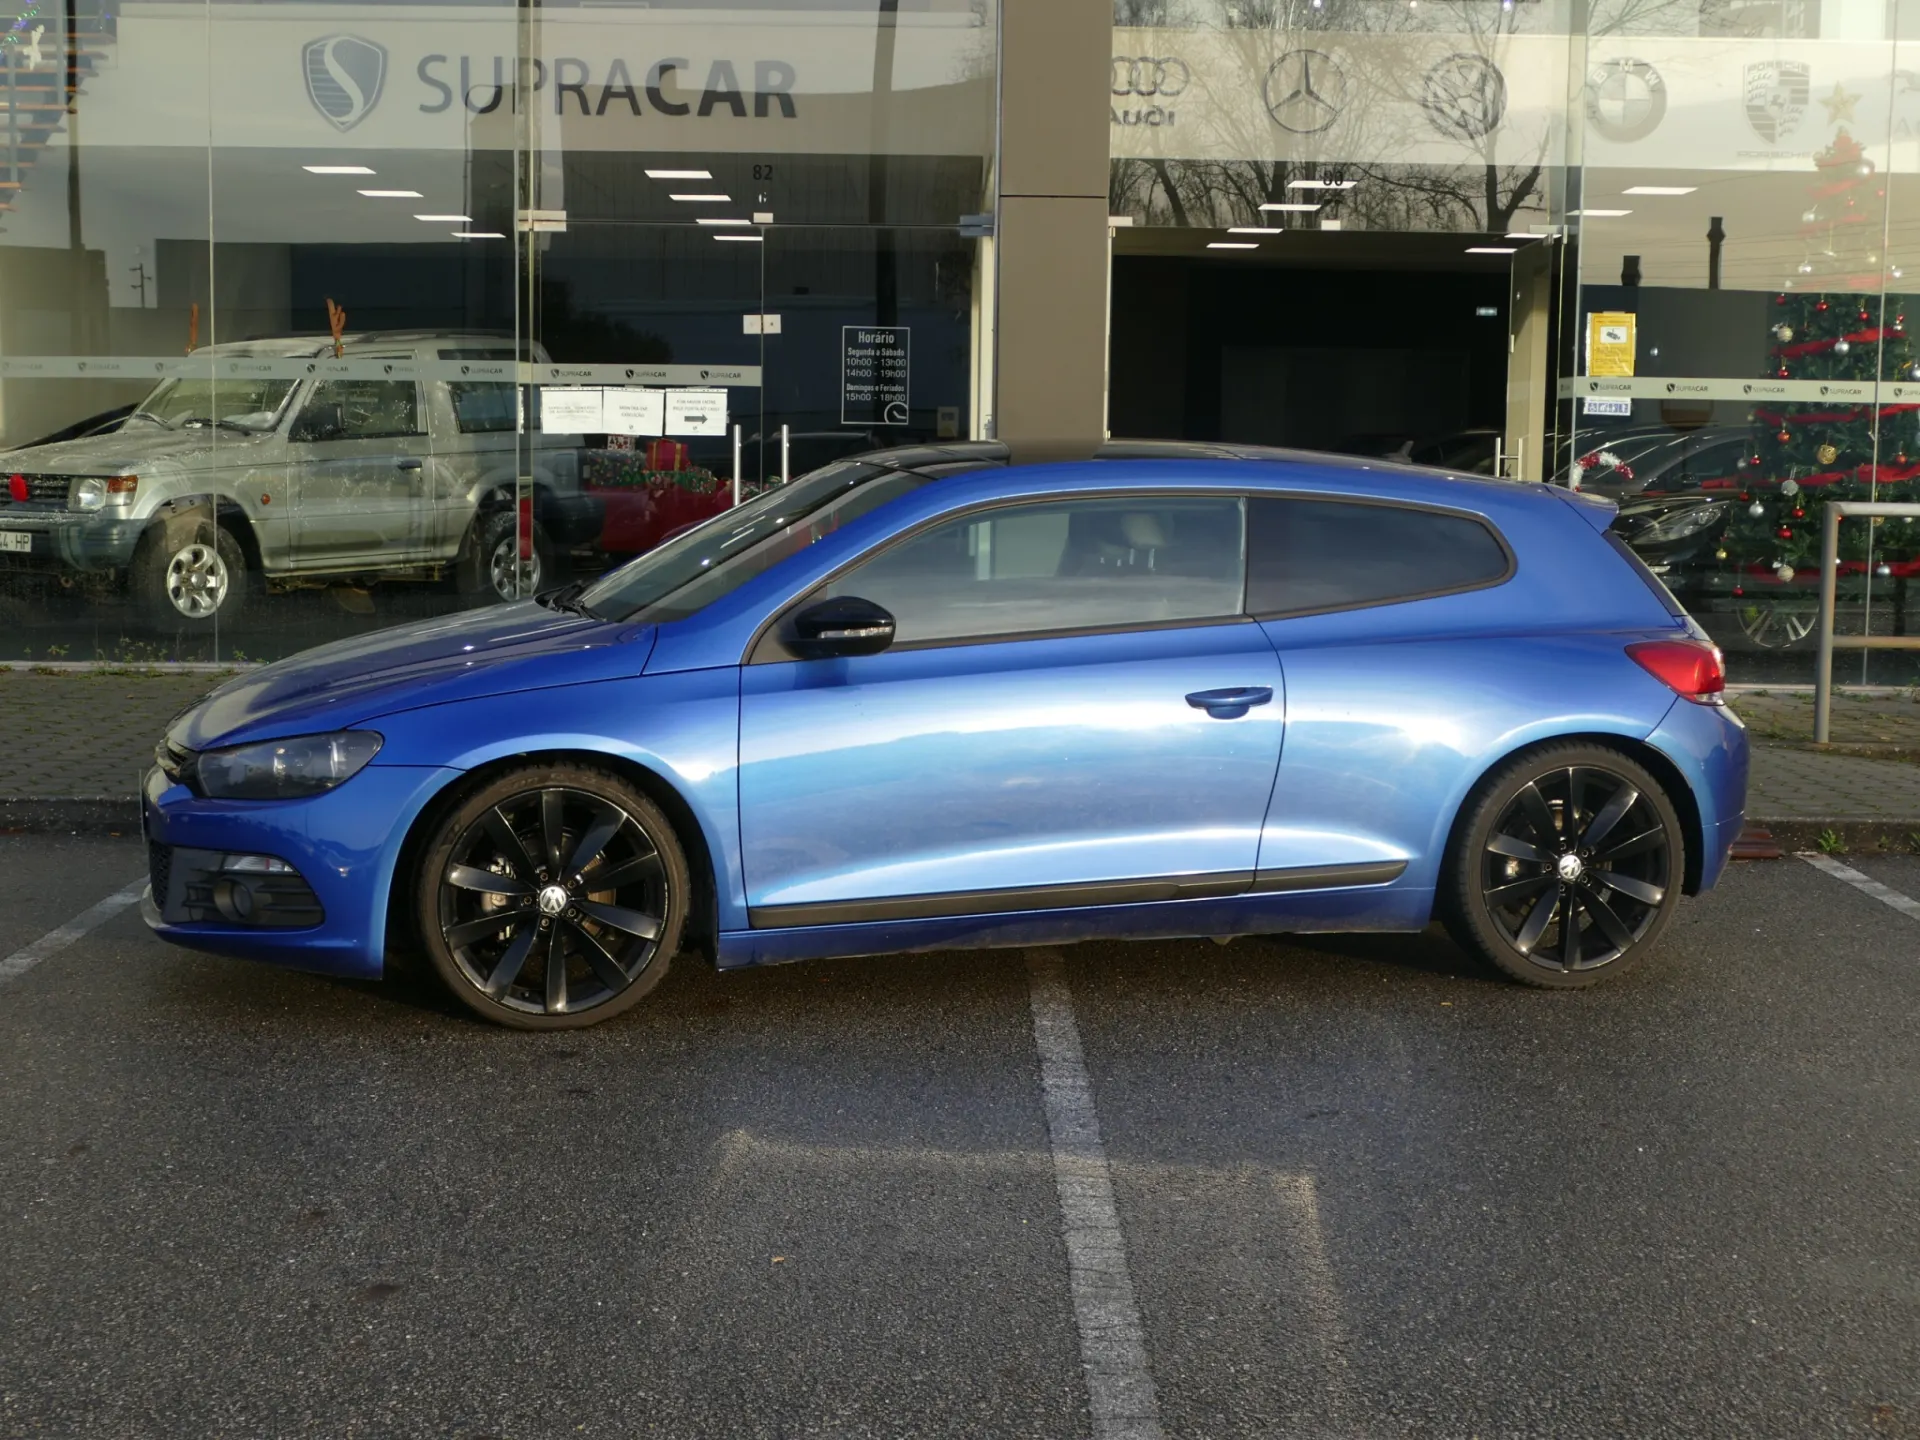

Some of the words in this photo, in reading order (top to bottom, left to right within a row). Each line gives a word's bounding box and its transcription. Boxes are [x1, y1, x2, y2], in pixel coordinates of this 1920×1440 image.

[417, 54, 798, 118] SUPRACAR
[753, 164, 773, 180] 82
[858, 331, 895, 344] Horário
[847, 347, 874, 357] Segunda
[881, 348, 904, 356] Sábado
[846, 358, 872, 366] 10h00
[881, 359, 906, 367] 13h00
[846, 369, 871, 377] 14h00
[881, 369, 906, 378] 19h00
[846, 383, 874, 392] Domingos
[880, 384, 904, 392] Feriados
[1753, 386, 1786, 394] SUPRACAR
[846, 393, 871, 401] 15h00
[880, 393, 906, 401] 18h00
